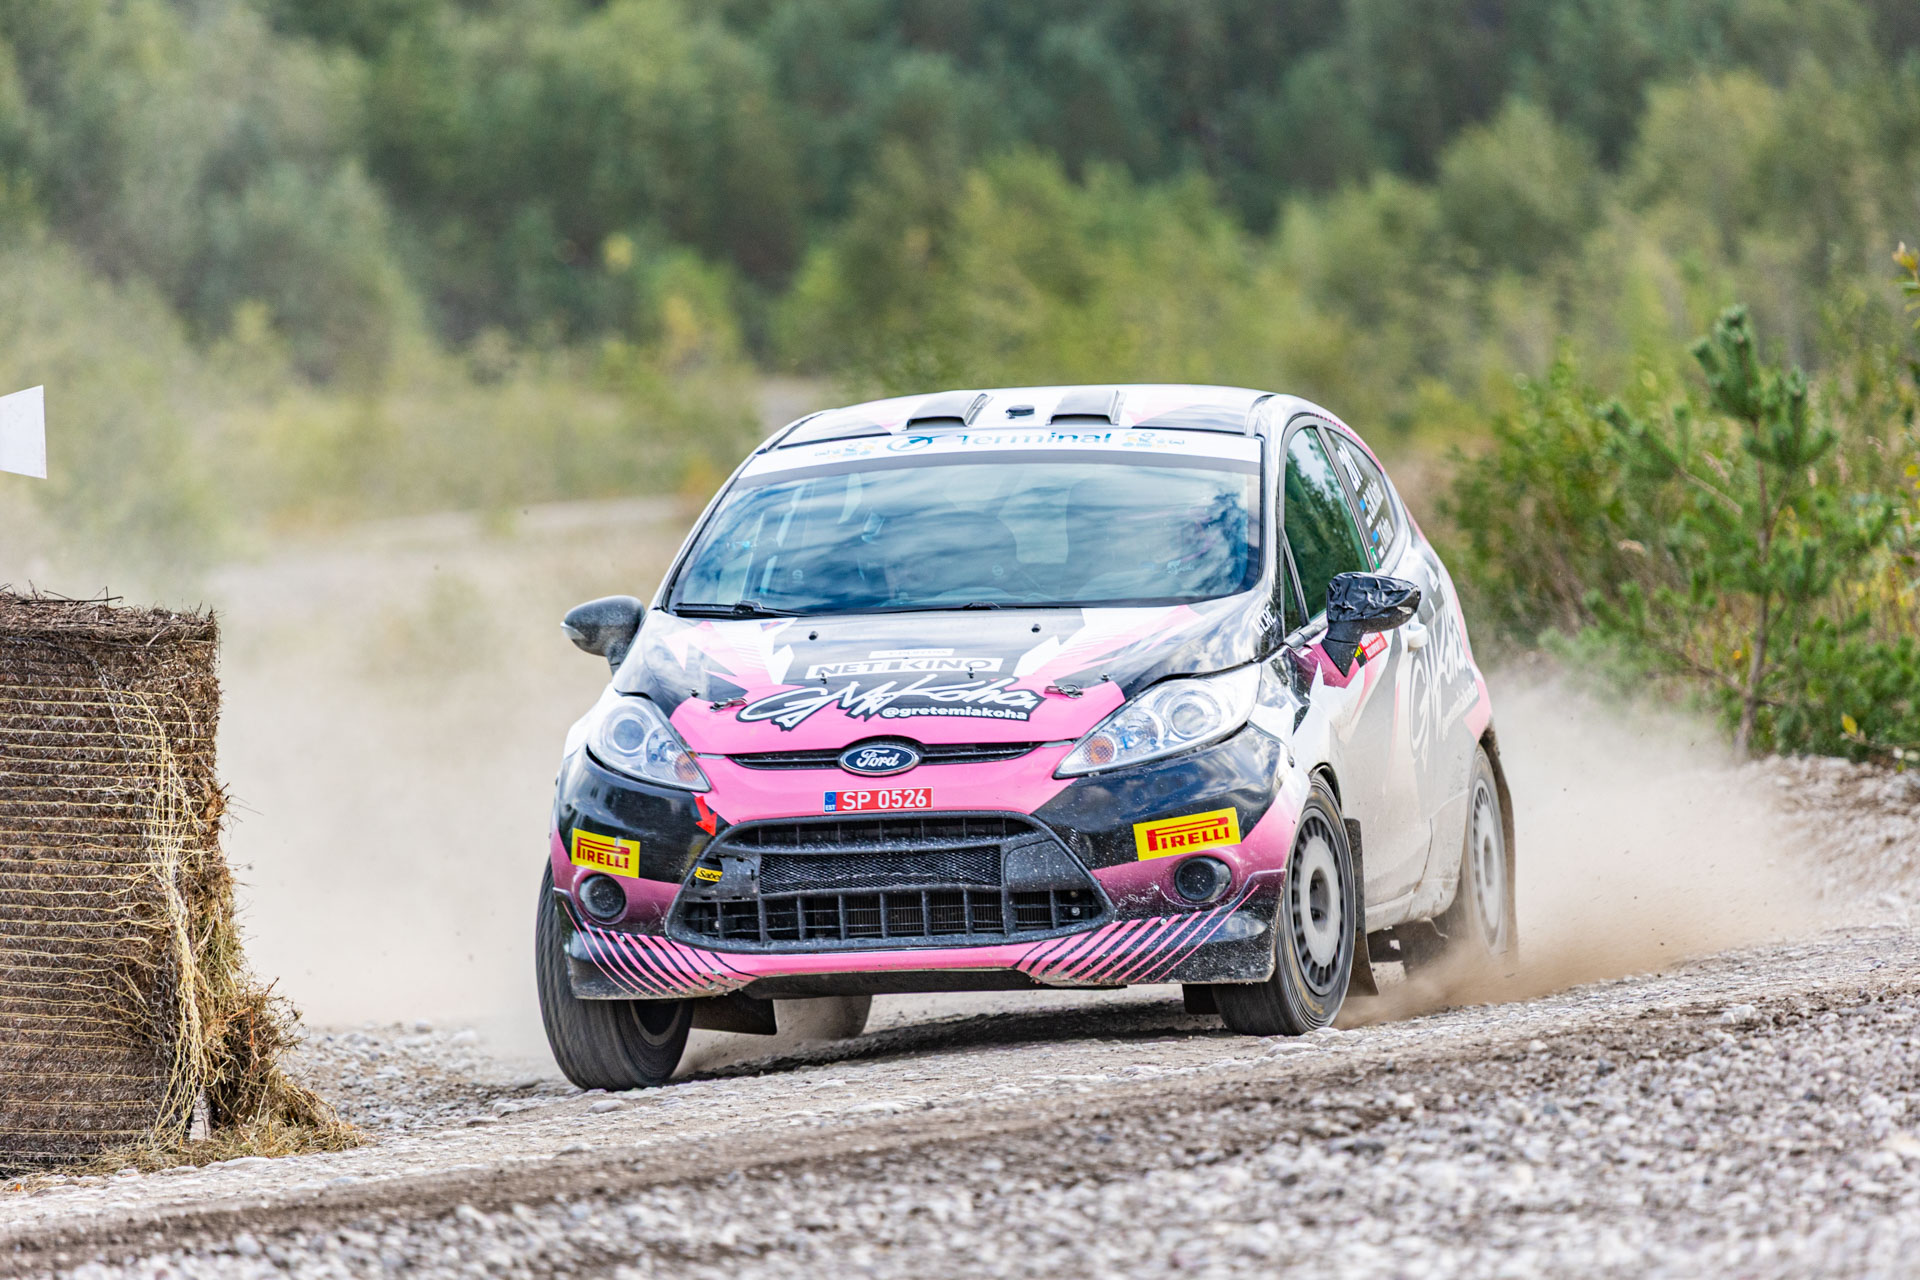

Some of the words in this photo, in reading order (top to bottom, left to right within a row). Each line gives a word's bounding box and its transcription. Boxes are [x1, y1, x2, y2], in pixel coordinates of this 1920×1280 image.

[955, 432, 1112, 446] Terminal
[882, 706, 1028, 720] @gretemiakoha
[856, 749, 900, 768] Ford
[842, 791, 871, 810] SP
[878, 789, 927, 809] 0526
[1146, 816, 1230, 852] PIRELLI
[576, 836, 631, 869] PIRELLI
